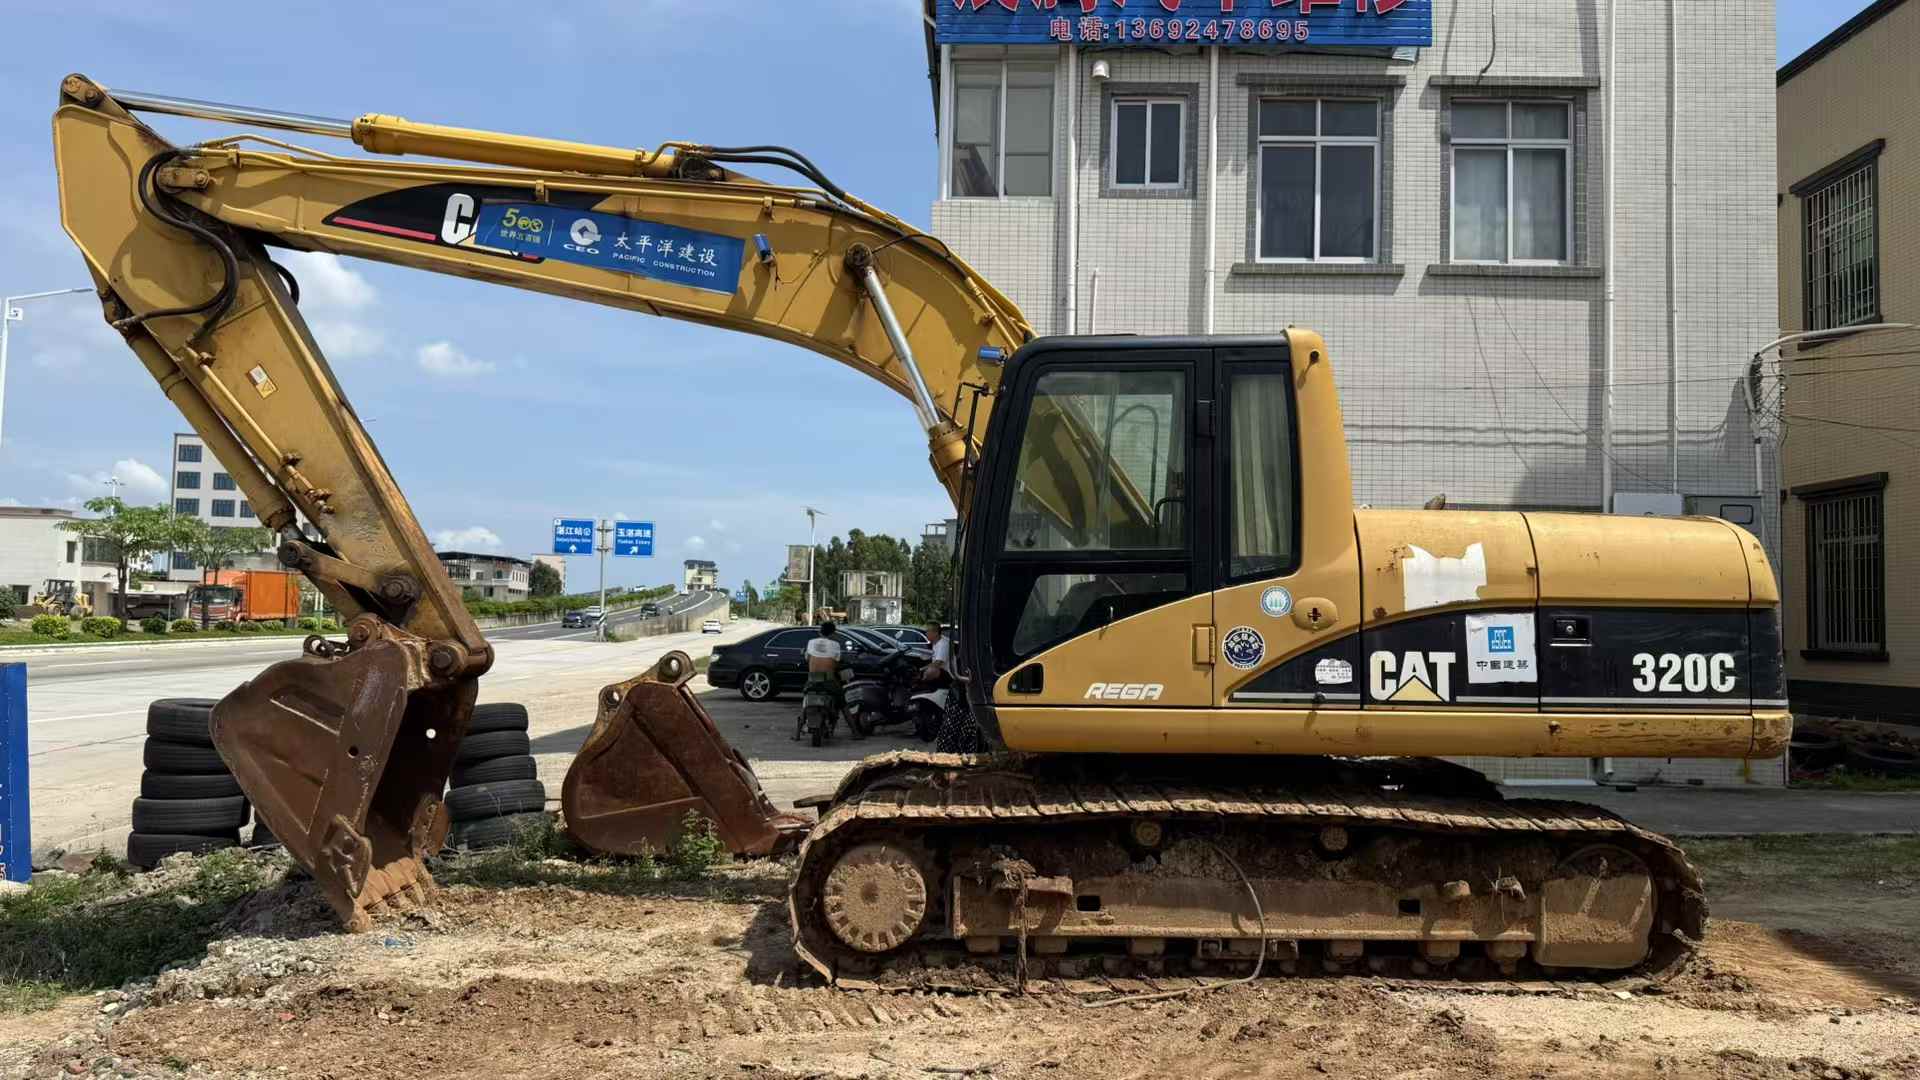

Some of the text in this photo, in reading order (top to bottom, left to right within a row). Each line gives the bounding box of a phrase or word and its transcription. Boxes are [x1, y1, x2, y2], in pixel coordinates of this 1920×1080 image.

[1049, 16, 1310, 41] 电话:13692478695
[612, 252, 715, 278] PACIFIC CONSTRUCTION
[614, 231, 718, 267] 太平洋建设
[1370, 650, 1456, 702] CAT
[1632, 652, 1737, 693] 320C
